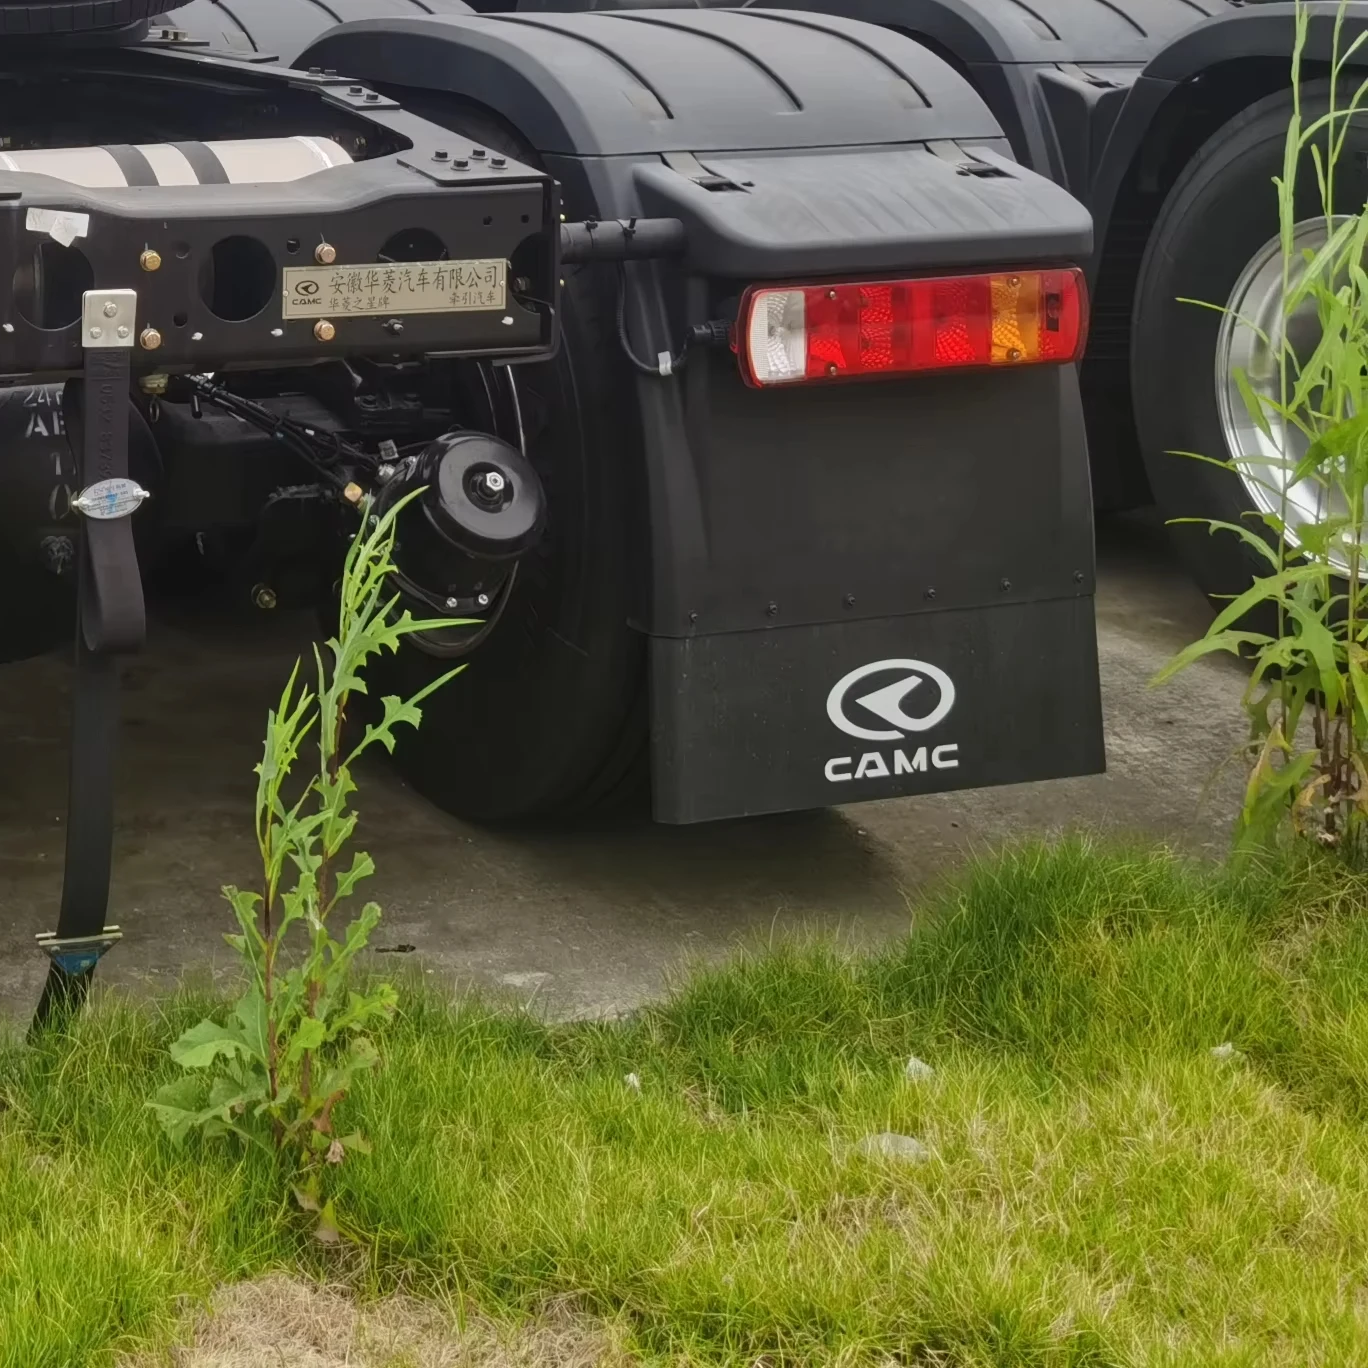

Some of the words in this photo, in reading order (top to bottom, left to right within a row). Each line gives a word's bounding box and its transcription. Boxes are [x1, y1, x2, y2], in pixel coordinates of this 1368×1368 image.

[328, 265, 497, 295] 安徽华菱汽车有限公司
[292, 297, 322, 306] CAMC
[329, 296, 391, 312] 华菱之星牌
[448, 290, 496, 307] 牵引汽车
[824, 743, 959, 782] CAMC
